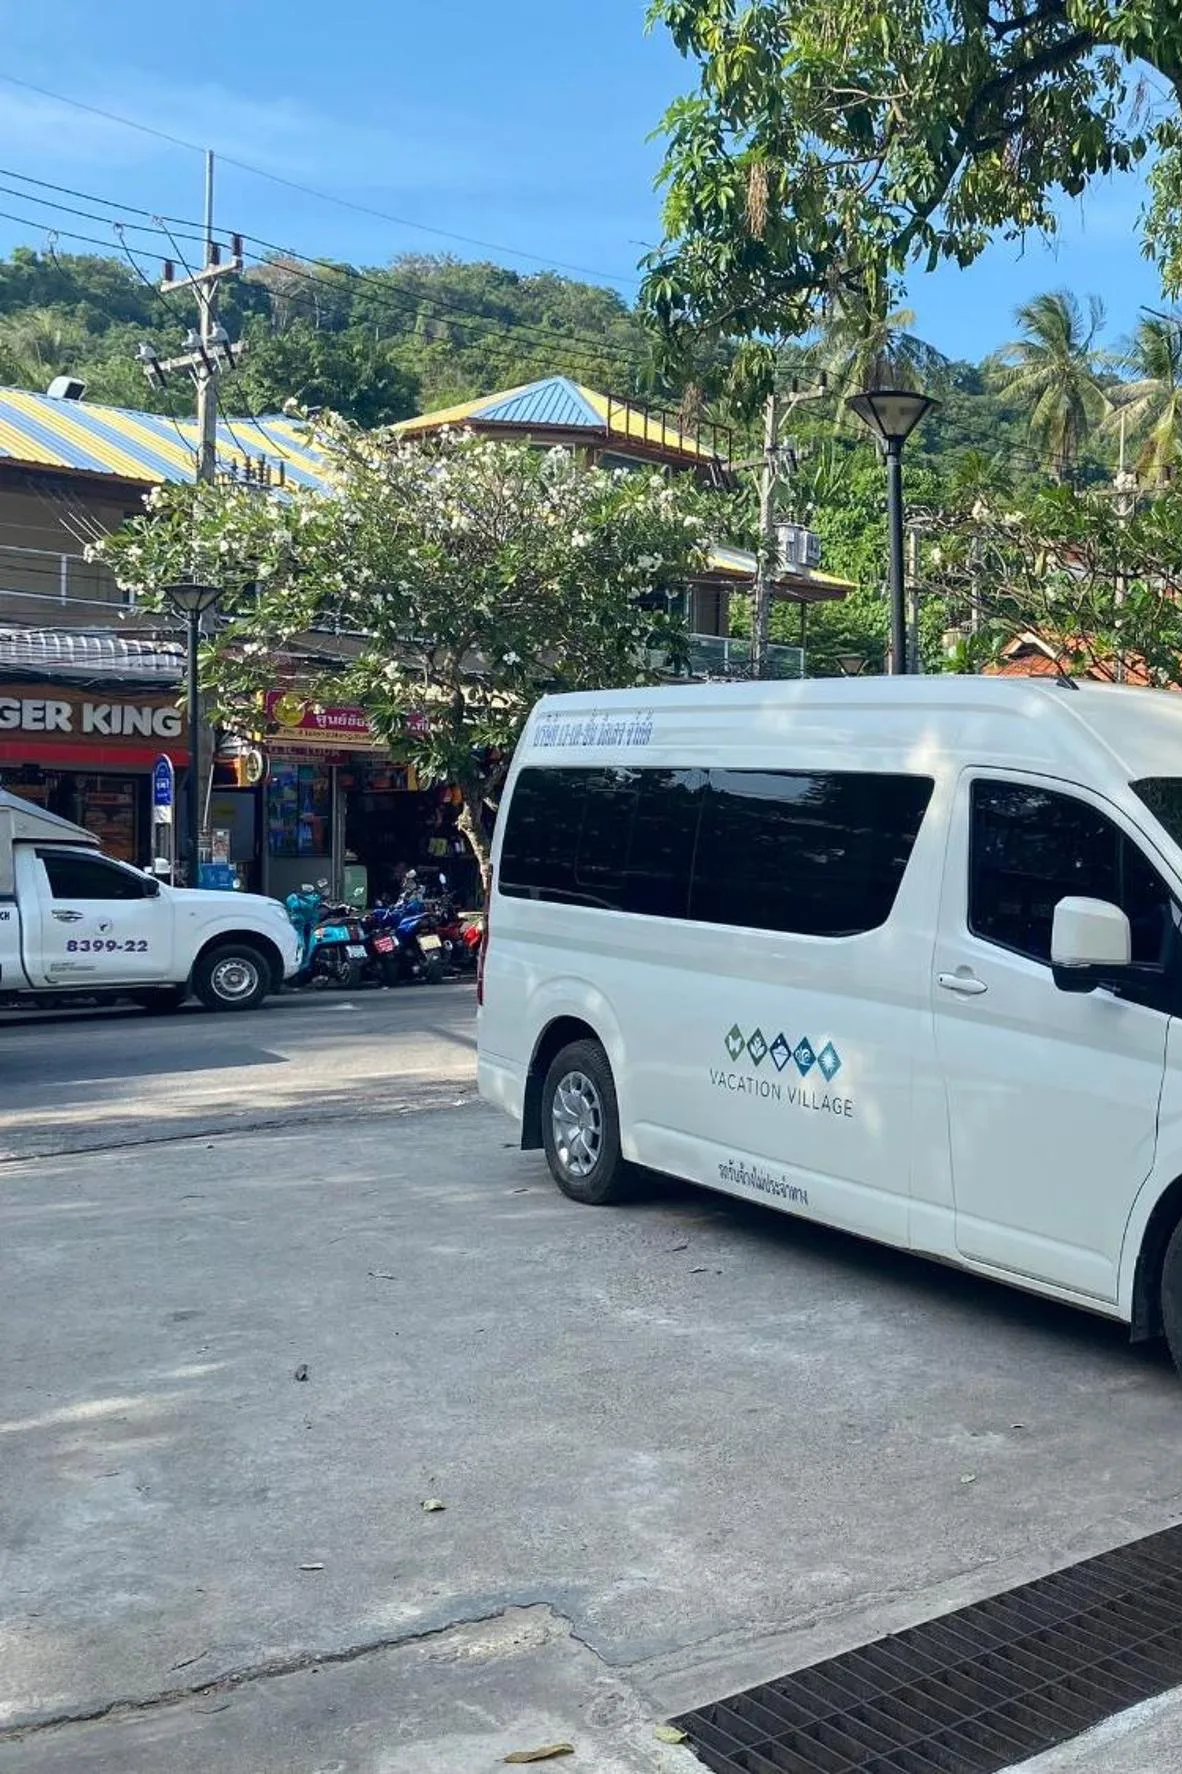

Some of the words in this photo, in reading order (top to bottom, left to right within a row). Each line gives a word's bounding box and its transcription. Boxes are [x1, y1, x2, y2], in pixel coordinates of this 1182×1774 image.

[0, 697, 73, 732] GER
[82, 702, 182, 737] KING
[66, 940, 149, 952] 8399-22
[709, 1068, 781, 1100] VACATION
[787, 1087, 853, 1118] VILLAGE
